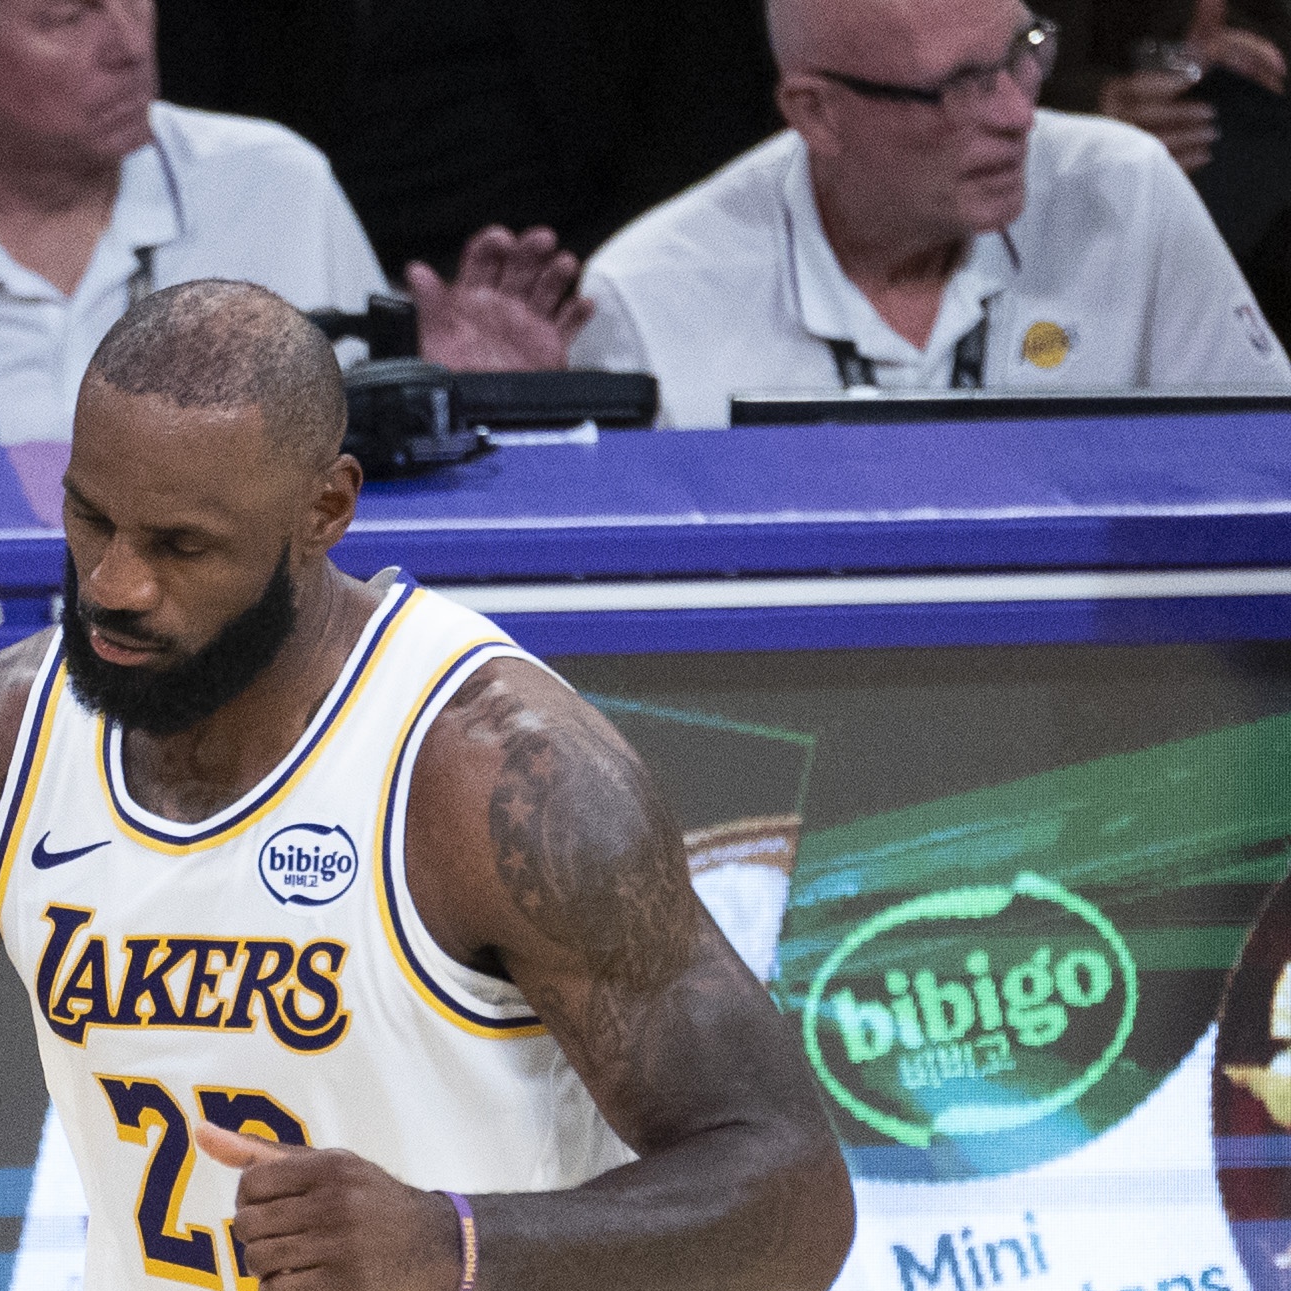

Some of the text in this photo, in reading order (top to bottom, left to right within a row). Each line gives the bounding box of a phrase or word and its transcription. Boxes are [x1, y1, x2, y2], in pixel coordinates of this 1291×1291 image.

[269, 844, 352, 882] bibigo
[284, 874, 319, 888] 비비고
[35, 902, 352, 1056] LAKERS
[830, 944, 1113, 1065] bibigo
[462, 1217, 477, 1282] PROMISE
